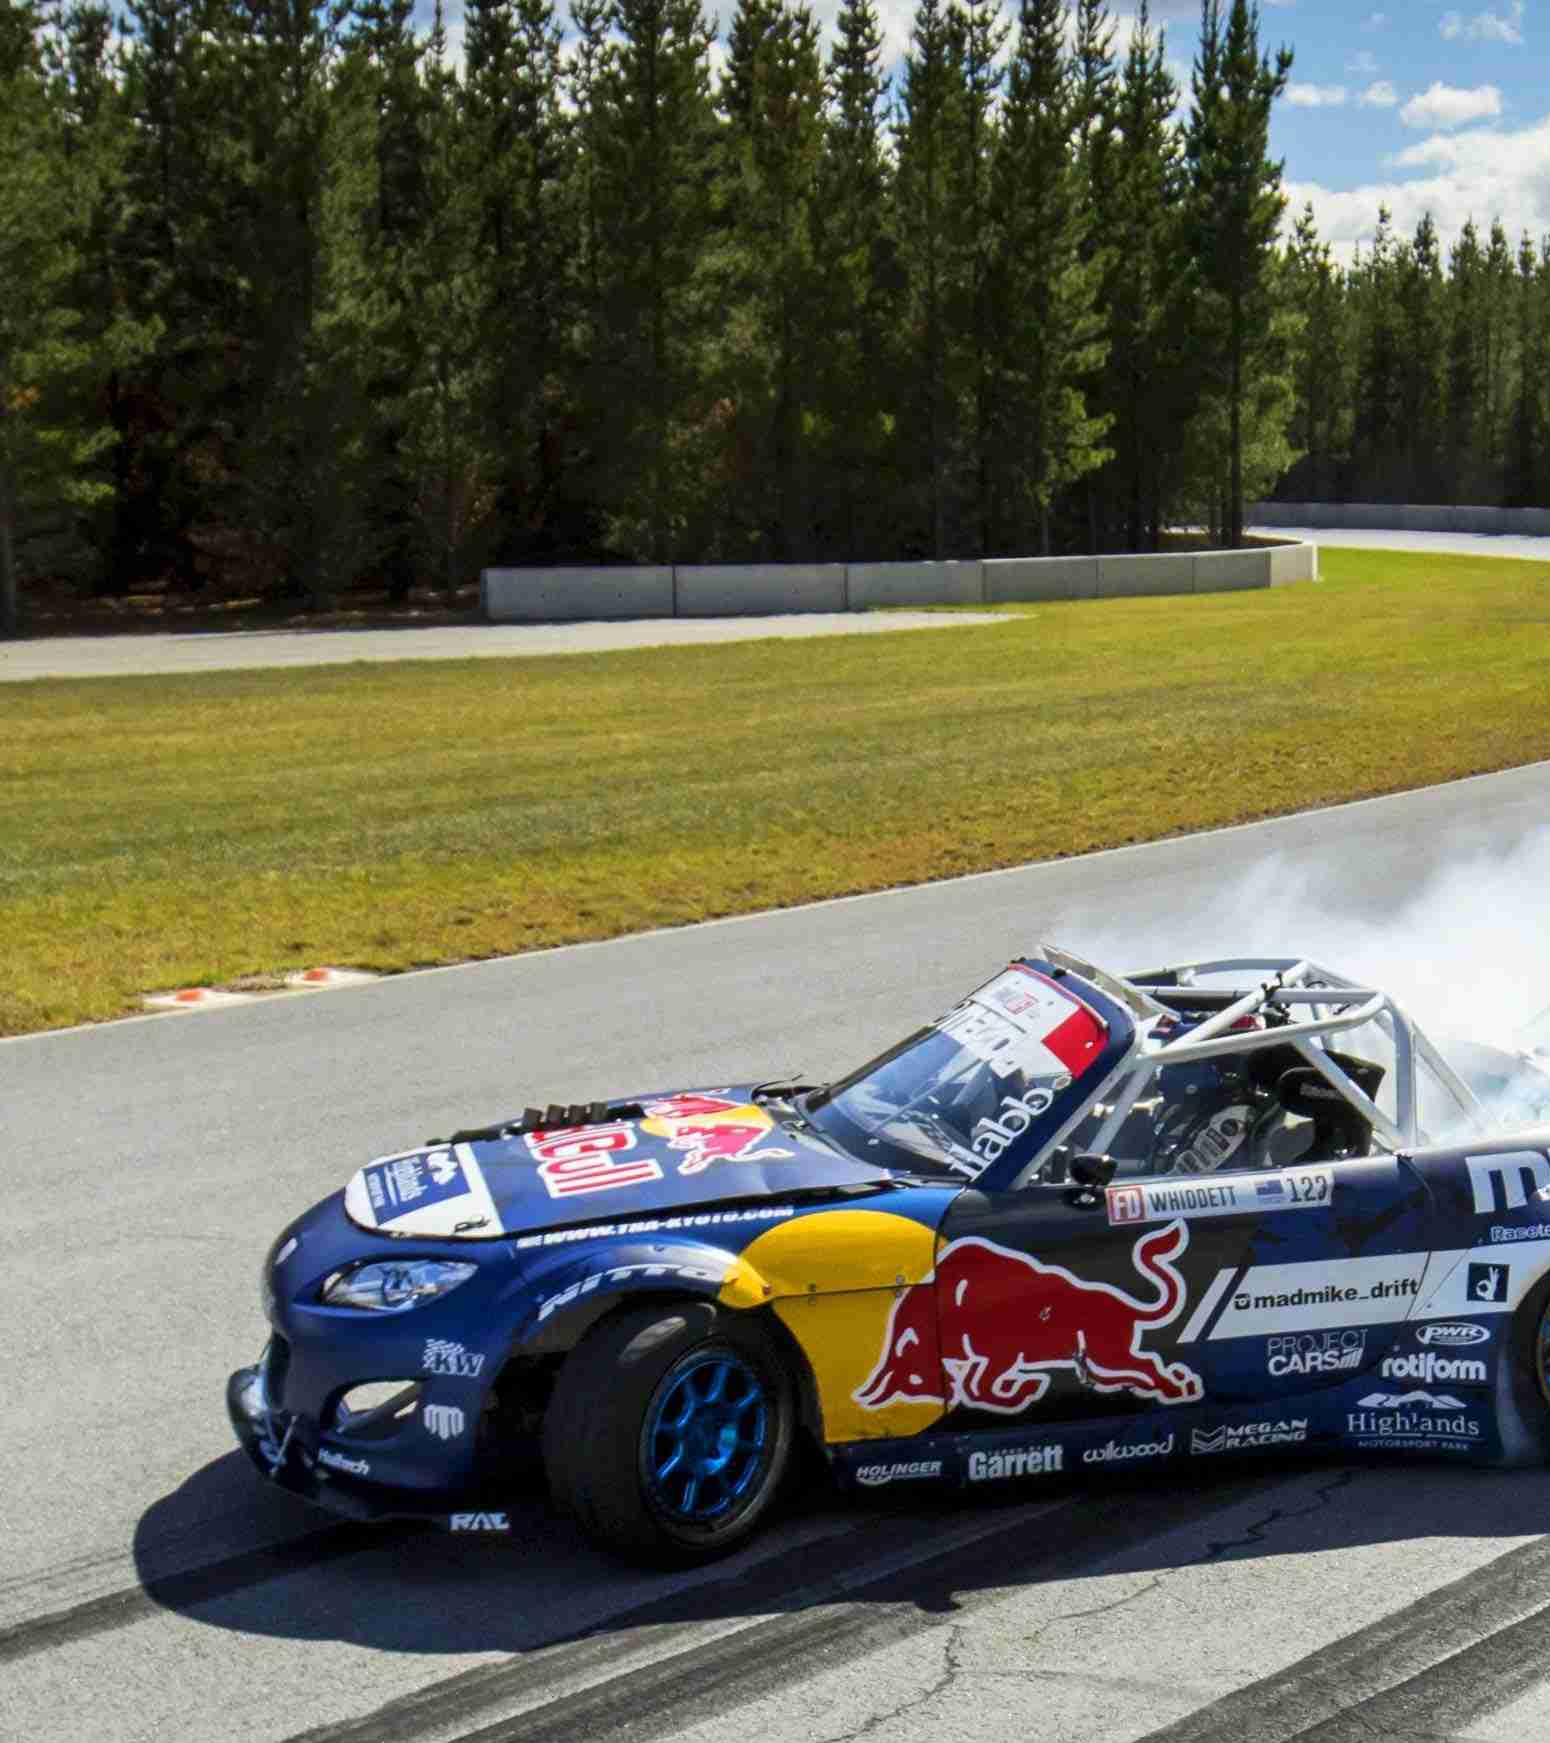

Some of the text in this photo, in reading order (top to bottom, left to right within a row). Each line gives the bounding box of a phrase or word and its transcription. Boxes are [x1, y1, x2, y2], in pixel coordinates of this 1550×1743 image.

[1151, 1186, 1237, 1212] WHIDDETT
[1254, 1279, 1419, 1310] madmike_drift
[1267, 1329, 1368, 1355] PROJECT
[1268, 1350, 1340, 1376] CARS
[1382, 1352, 1486, 1383] rotiform
[1227, 1418, 1308, 1437] MEGAN
[1346, 1411, 1480, 1436] Highlands
[1083, 1433, 1174, 1463] wilwood
[1226, 1430, 1306, 1448] RACING
[856, 1461, 942, 1481] HOLINGER
[968, 1445, 1063, 1481] Garrett
